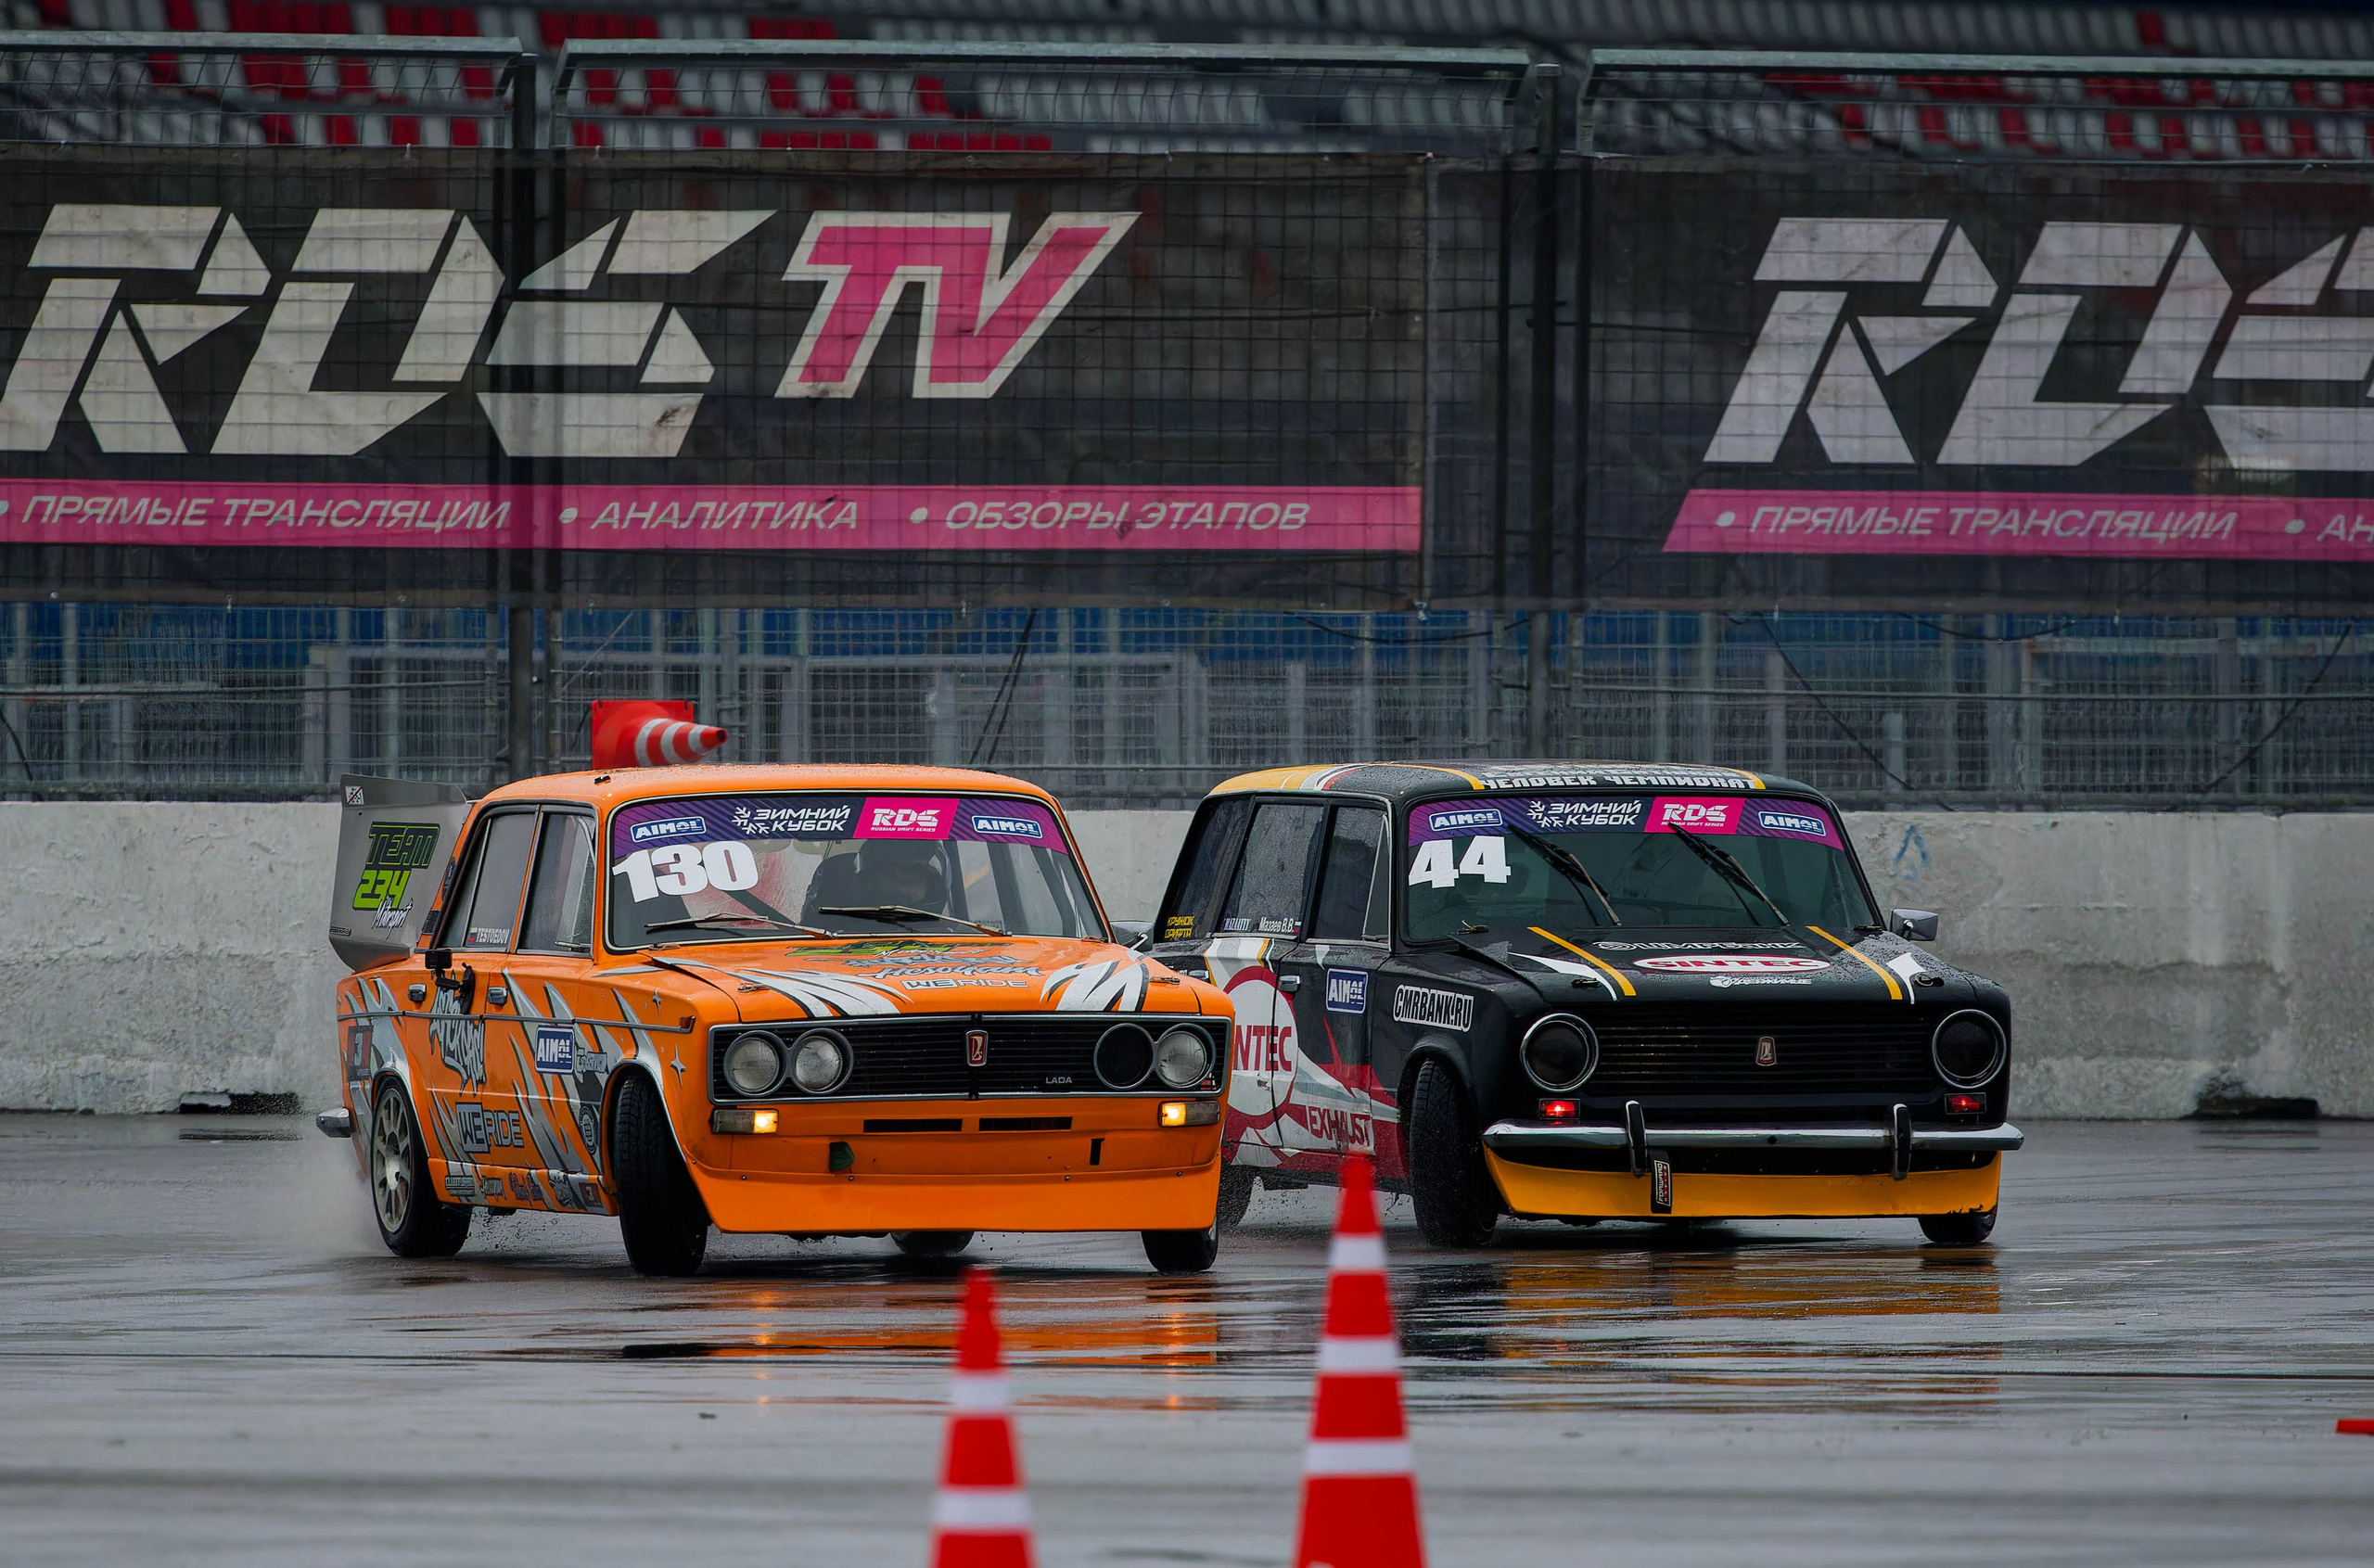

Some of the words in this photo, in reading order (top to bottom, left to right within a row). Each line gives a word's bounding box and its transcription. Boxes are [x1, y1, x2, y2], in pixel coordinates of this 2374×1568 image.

[774, 211, 1142, 398] TV
[21, 495, 214, 526] ПРЯМЫЕ
[223, 499, 511, 534] ТРАНСЛЯЦИИ
[590, 501, 858, 529] АНАЛИТИКА
[946, 502, 1130, 530] ОБЗОРЫ
[1136, 503, 1310, 530] ЭТАПОВ
[1748, 506, 1941, 536] ПРЯМЫЕ
[1947, 508, 2238, 543] ТРАНСЛЯЦИИ
[1483, 776, 1597, 790] ЧЕЛОВЕК
[1603, 775, 1755, 790] ЧЕМПИОНАТ
[753, 805, 851, 821] ЗИМНИЙ
[1548, 799, 1642, 814] ЗИМНИЙ
[1663, 803, 1729, 822] RDS
[772, 820, 848, 833] КУБОК
[873, 809, 941, 827] RDS
[976, 820, 1040, 835] AIMOL
[1434, 813, 1500, 828] AIMOL
[1565, 813, 1639, 826] КУБОК
[1764, 815, 1823, 834] AIMOL
[635, 820, 703, 839] AIMOL
[366, 822, 440, 869] TEAM
[612, 840, 759, 903] 130
[1408, 835, 1512, 889] 44
[353, 869, 413, 911] 234
[1646, 959, 1819, 968] SINTEC
[1328, 976, 1365, 1004] AIMOL
[1394, 986, 1474, 1031] CMRBANK.RU
[537, 1038, 572, 1064] AIMOL
[1233, 1025, 1292, 1071] NTEC
[1308, 1106, 1371, 1147] EXHAUST
